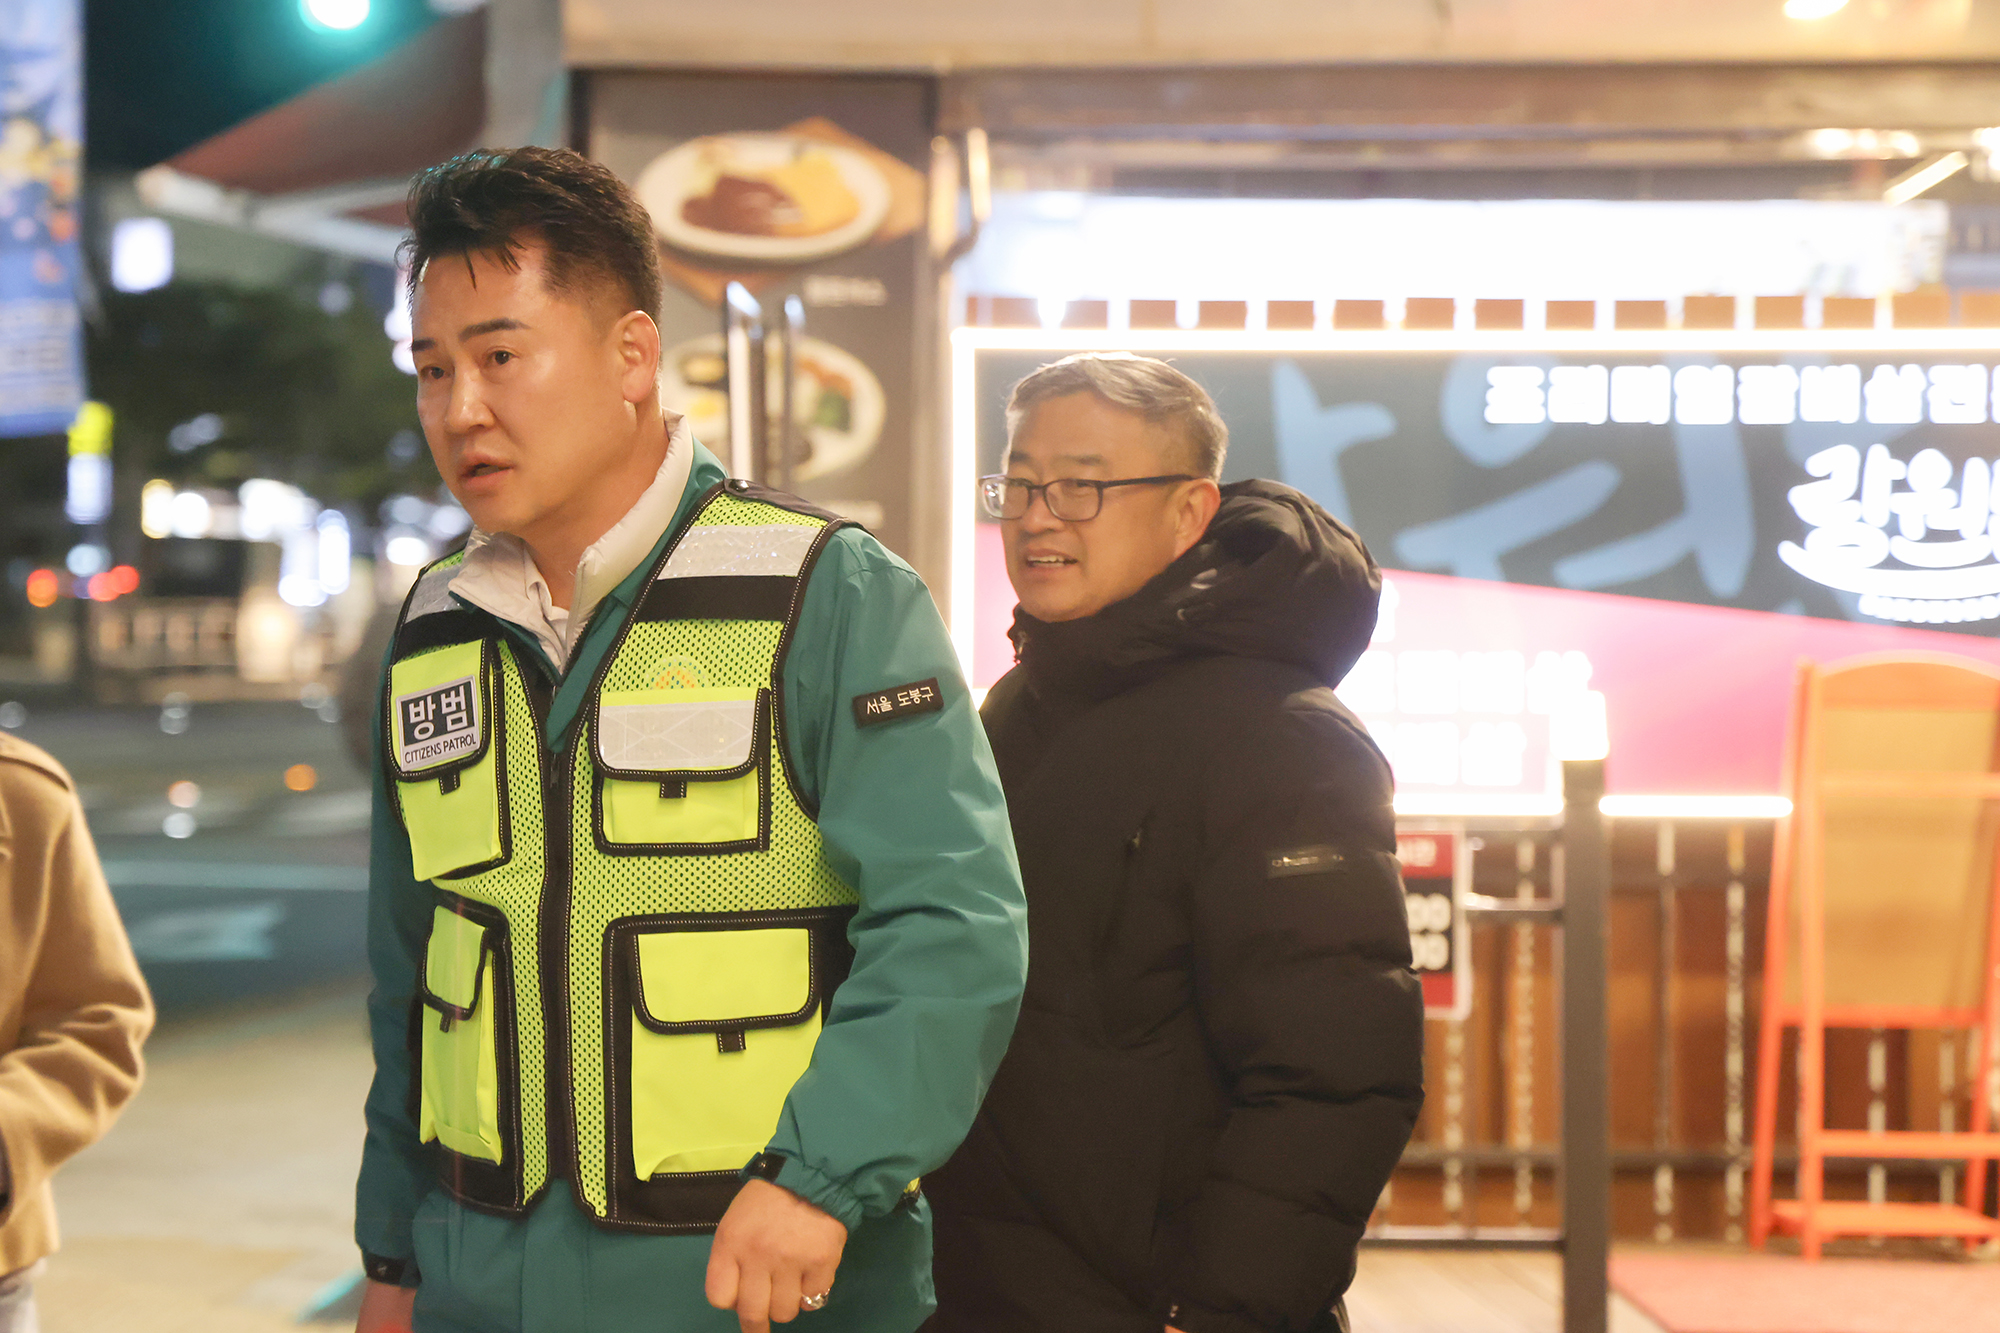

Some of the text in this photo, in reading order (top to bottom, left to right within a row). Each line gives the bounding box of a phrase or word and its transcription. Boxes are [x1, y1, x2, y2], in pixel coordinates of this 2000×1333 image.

[408, 685, 468, 740] 방범
[867, 686, 934, 715] 서울 도봉구
[404, 733, 476, 763] CITIZENS PATROL
